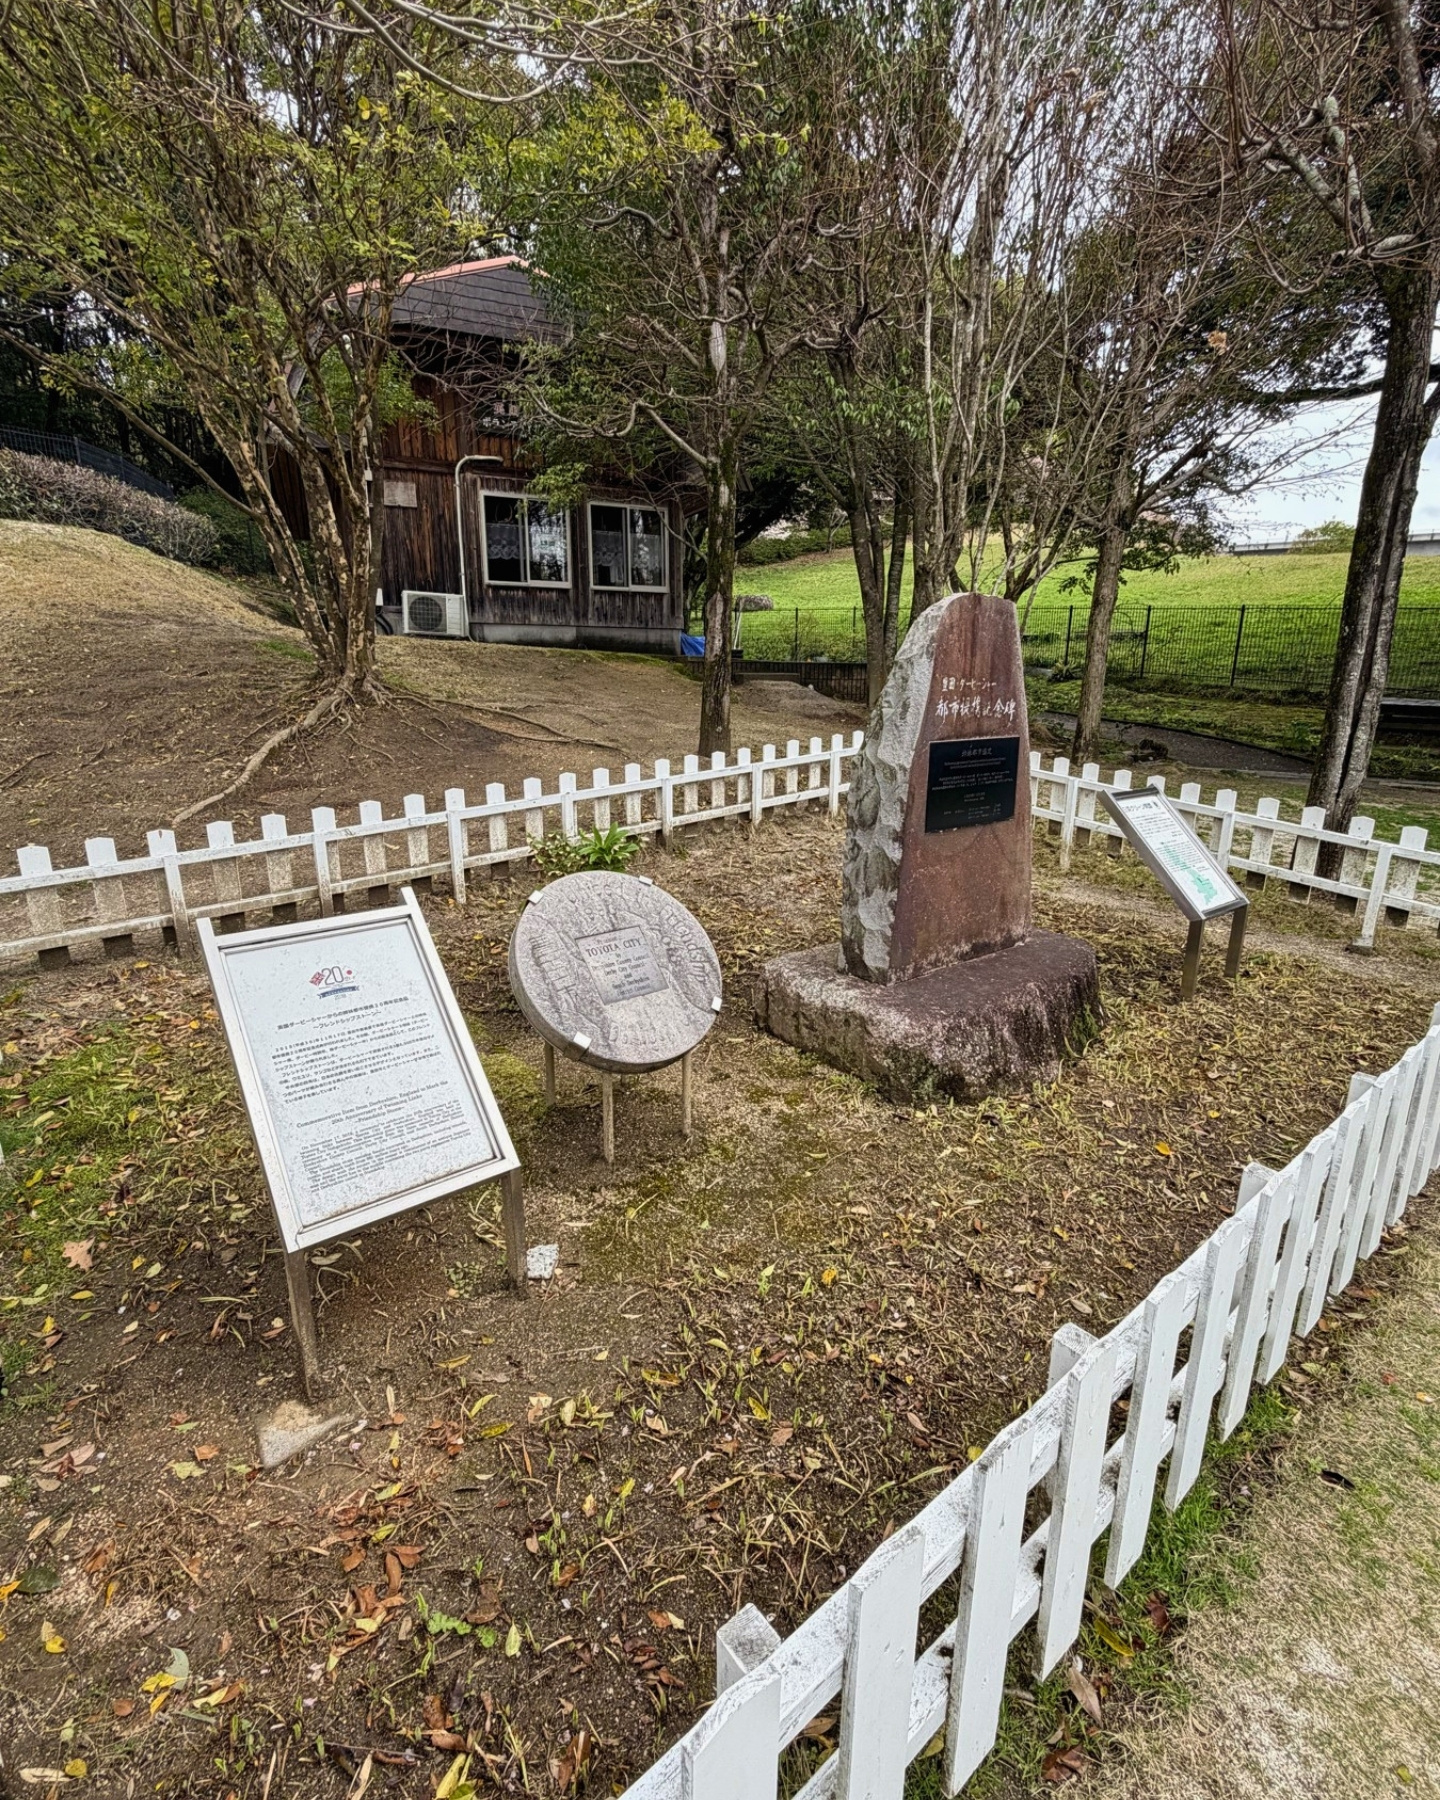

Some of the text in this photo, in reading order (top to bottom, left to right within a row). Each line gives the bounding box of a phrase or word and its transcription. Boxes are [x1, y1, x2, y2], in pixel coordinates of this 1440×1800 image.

[585, 942, 620, 957] TOYOTA
[623, 936, 642, 948] CITY
[321, 965, 343, 985] 20
[296, 1111, 341, 1128] Commemorative
[398, 1087, 420, 1099] England
[424, 1081, 439, 1090] Mark
[344, 1107, 376, 1120] Anniversary
